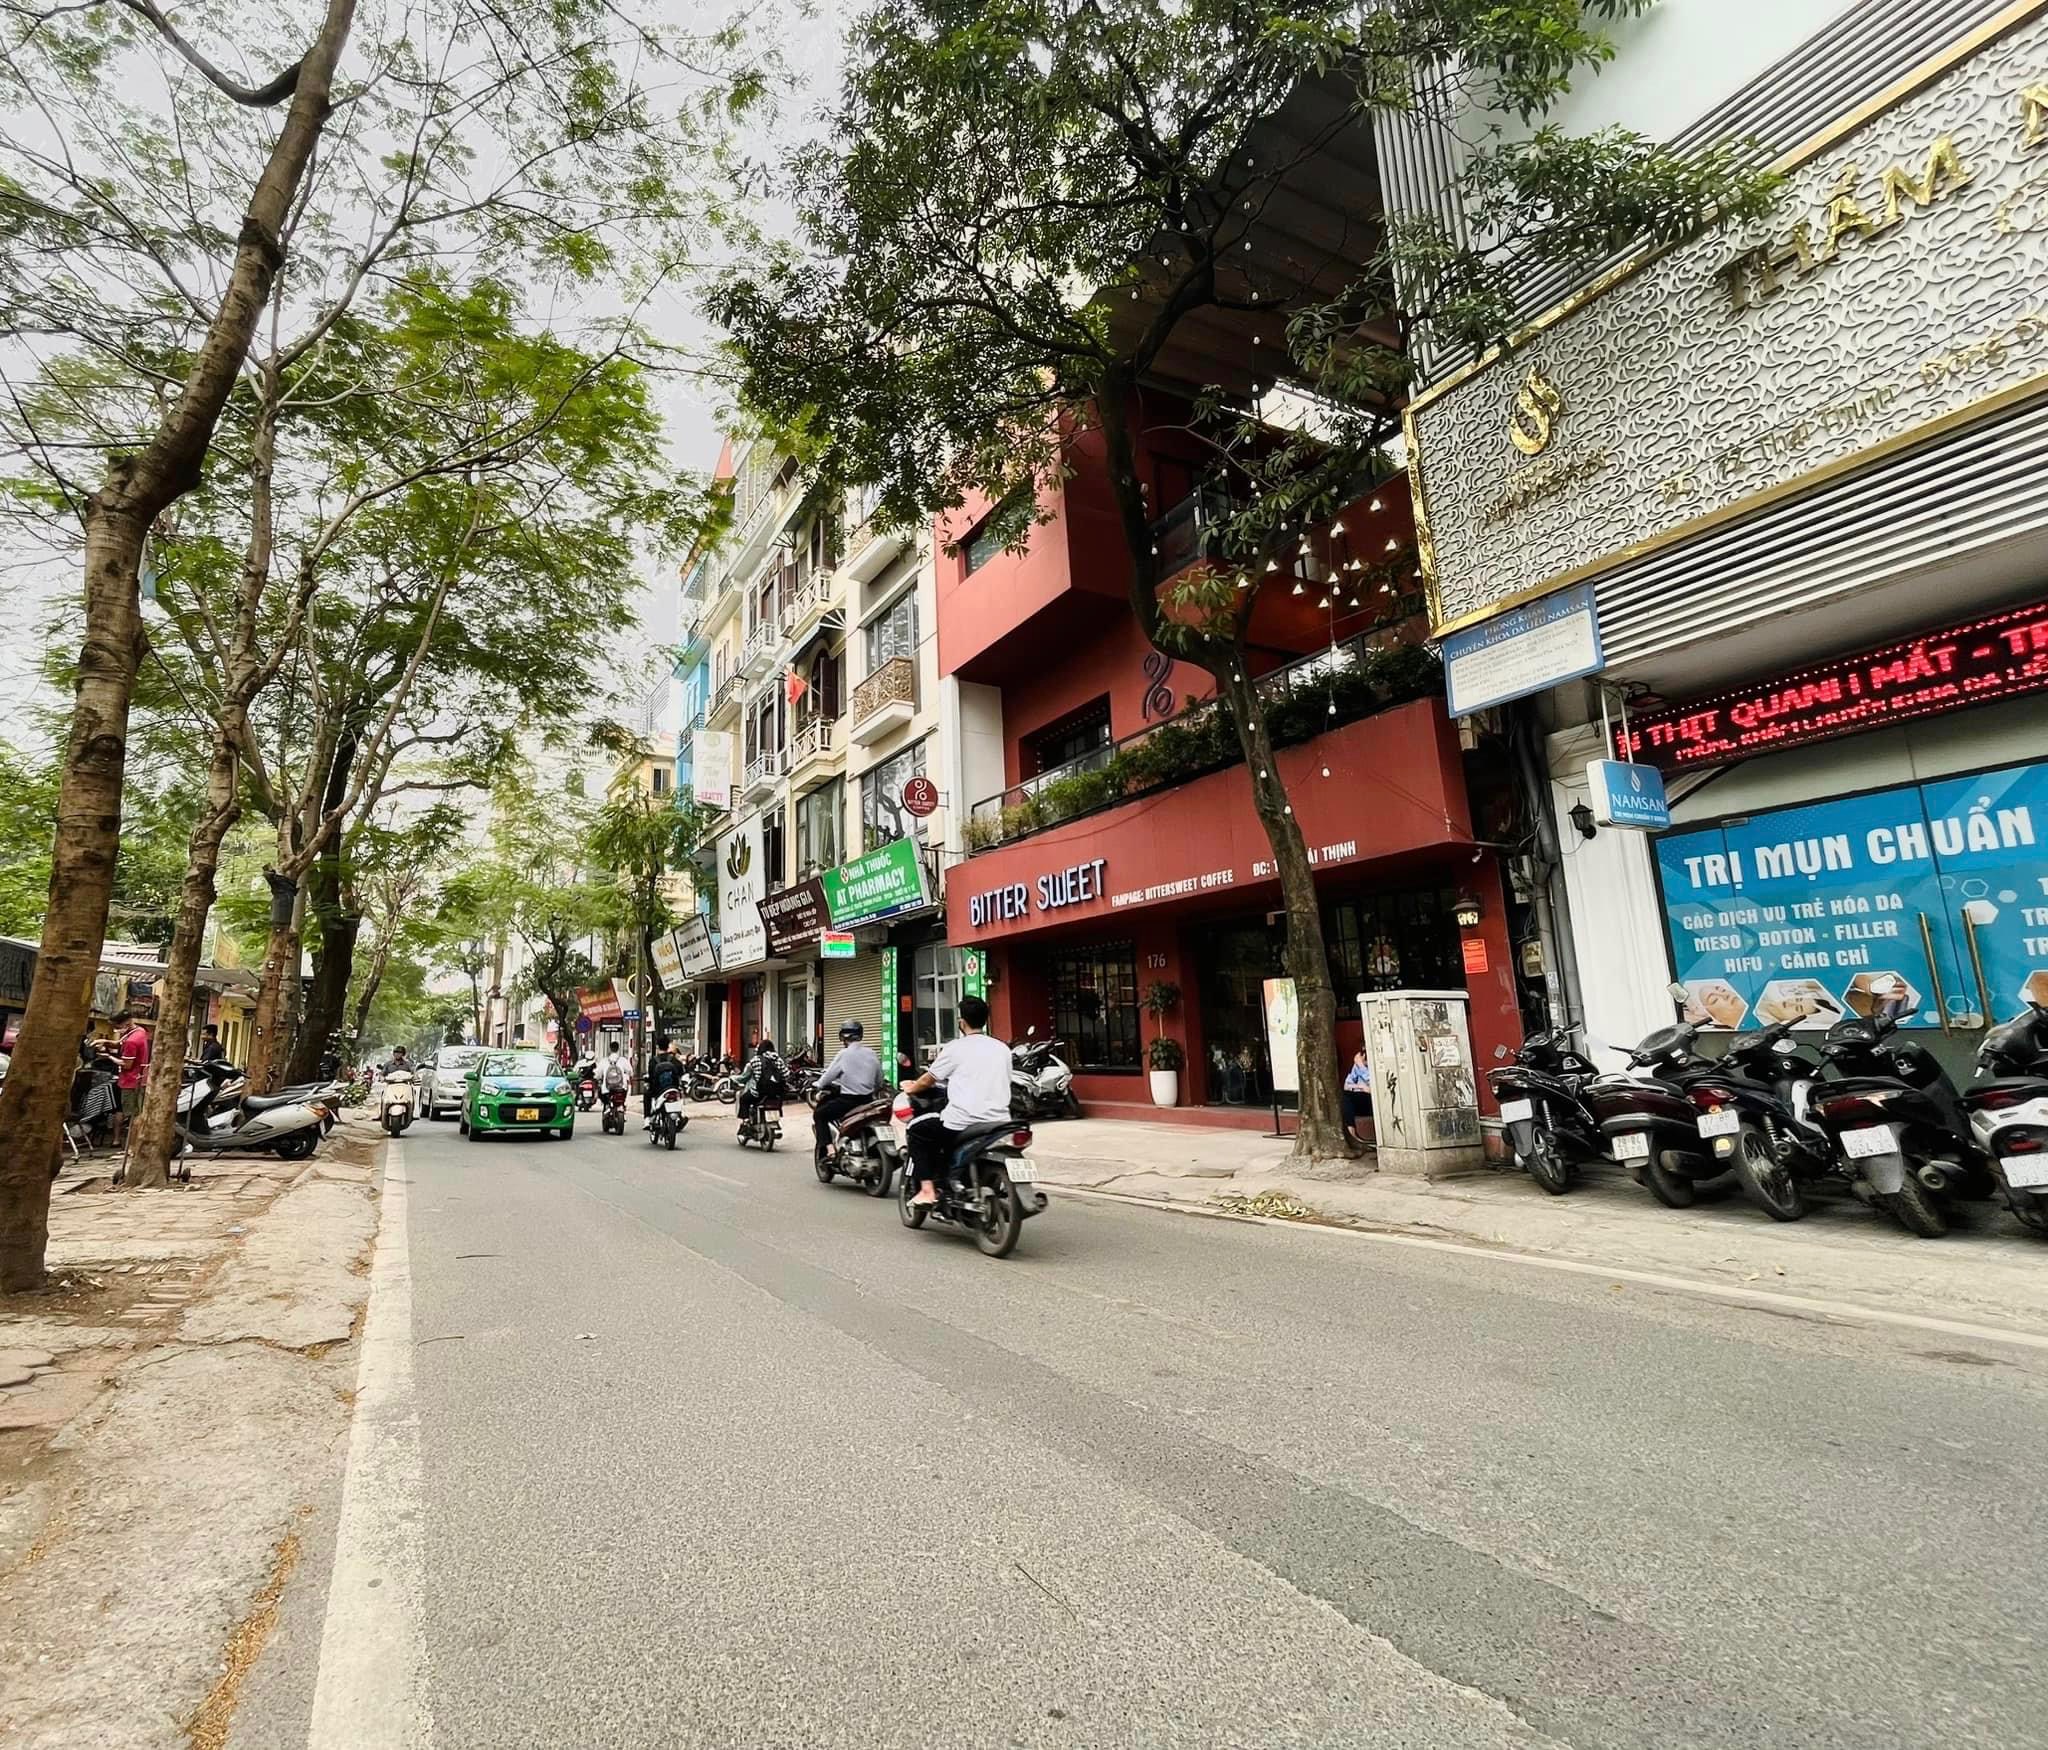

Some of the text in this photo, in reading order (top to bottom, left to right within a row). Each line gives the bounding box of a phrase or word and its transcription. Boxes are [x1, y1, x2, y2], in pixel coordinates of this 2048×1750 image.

[1548, 599, 1589, 622] NAMSAN
[1611, 793, 1665, 812] NAMSAN
[1321, 840, 1357, 862] THỊNH
[1683, 795, 2036, 890] TRỊ MỤN CHUẨN
[848, 850, 892, 881] NHÀ THUỐC
[1252, 861, 1271, 877] ĐC:
[800, 889, 815, 907] GIA
[836, 866, 906, 907] AT PHARMACY
[970, 882, 1029, 928] BITTER
[1035, 857, 1107, 911] SWEET
[1111, 869, 1234, 908] FANPAGE: BITTERSWEET COFFEE
[1682, 893, 1904, 931] CÁC DỊCH VỤ TRẺ HÓA DA
[1693, 920, 1899, 954] MESO BOTOX FILLER
[1147, 953, 1166, 969] 176
[1724, 944, 1870, 974] HIFU CĂNG CHỈ
